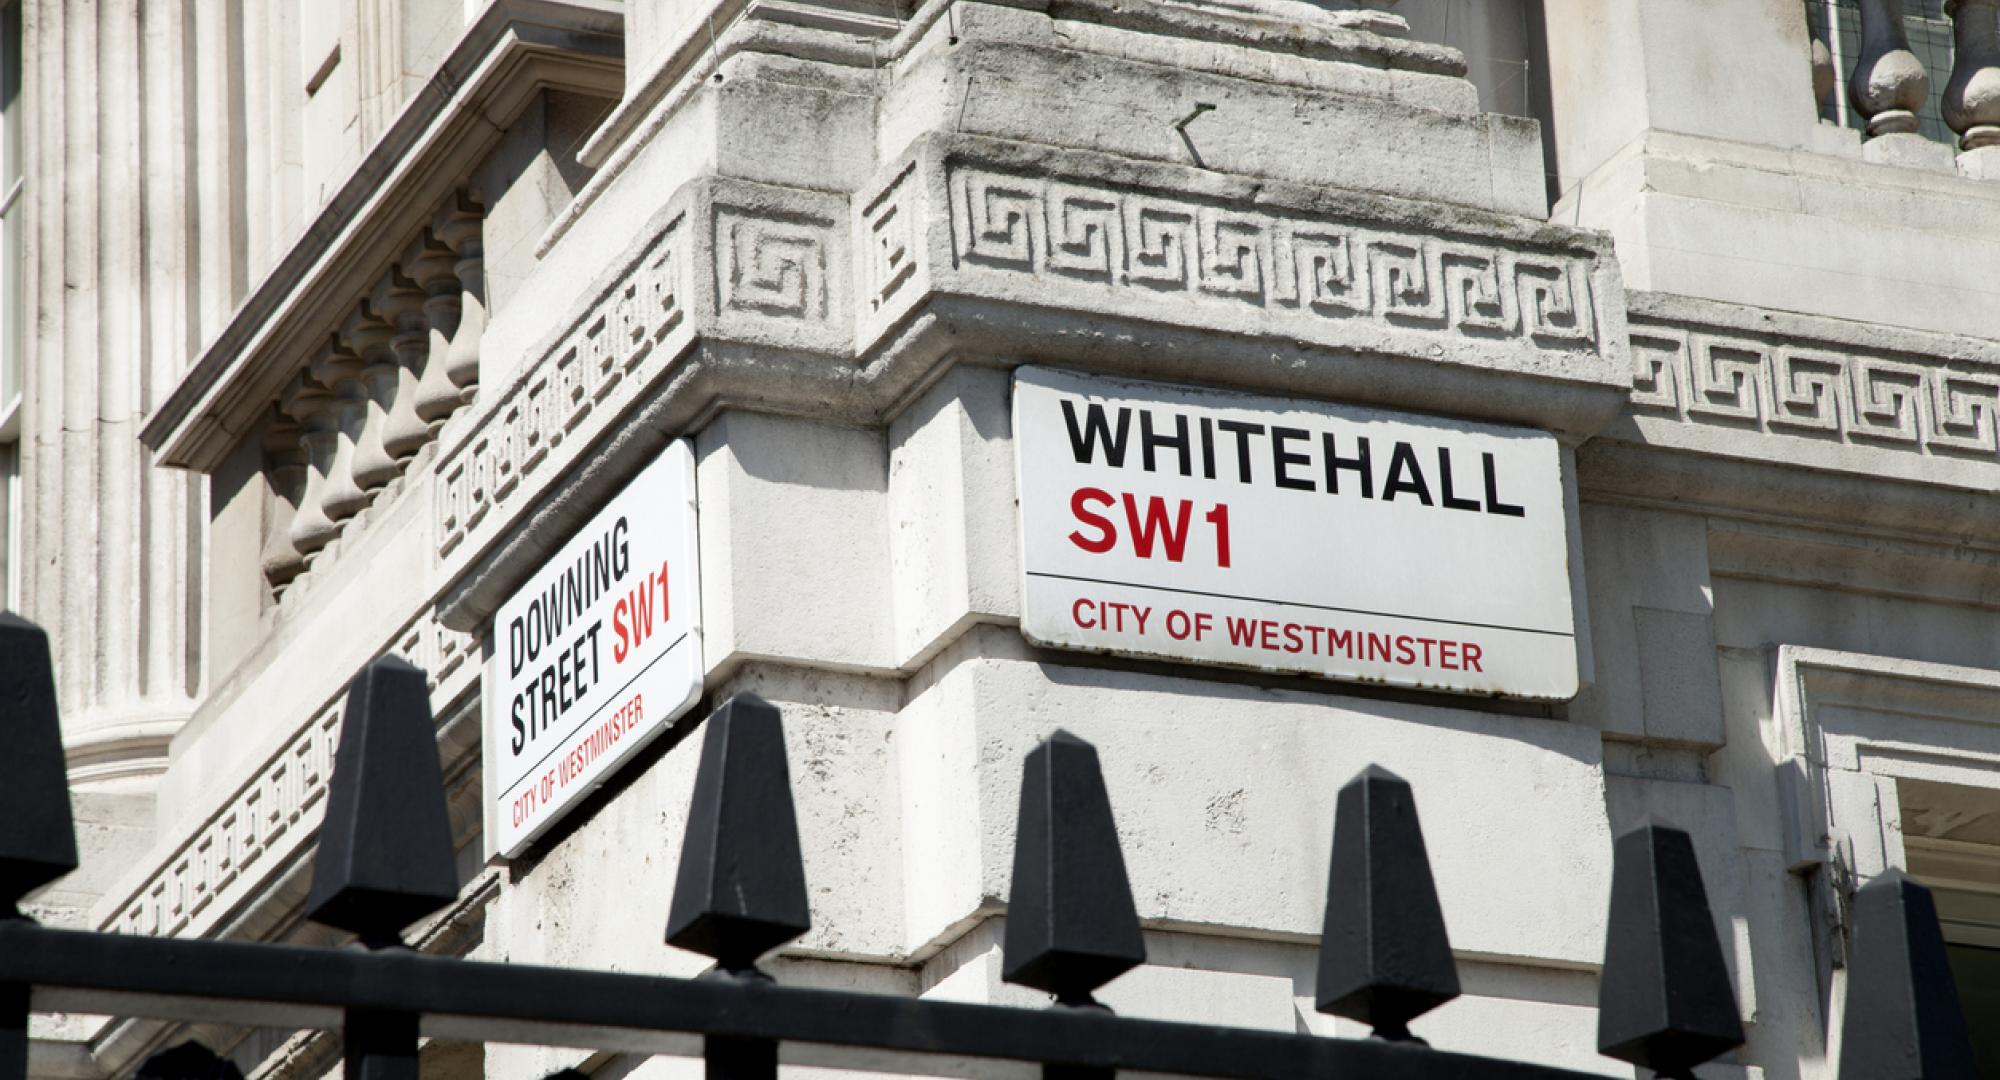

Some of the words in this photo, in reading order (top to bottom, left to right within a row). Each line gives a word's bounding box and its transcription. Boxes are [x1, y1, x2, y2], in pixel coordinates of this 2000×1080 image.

[1061, 400, 1524, 517] WHITEHALL
[1068, 487, 1231, 568] SW1
[510, 516, 629, 680] DOWNING
[511, 620, 602, 756] STREET
[613, 560, 670, 664] SW1
[1072, 598, 1151, 635] CITY
[1166, 610, 1213, 641] OF
[1227, 616, 1483, 673] WESTMINSTER
[513, 784, 537, 828] CITY
[541, 769, 555, 804] OF
[558, 694, 643, 788] WESTMINSTER
